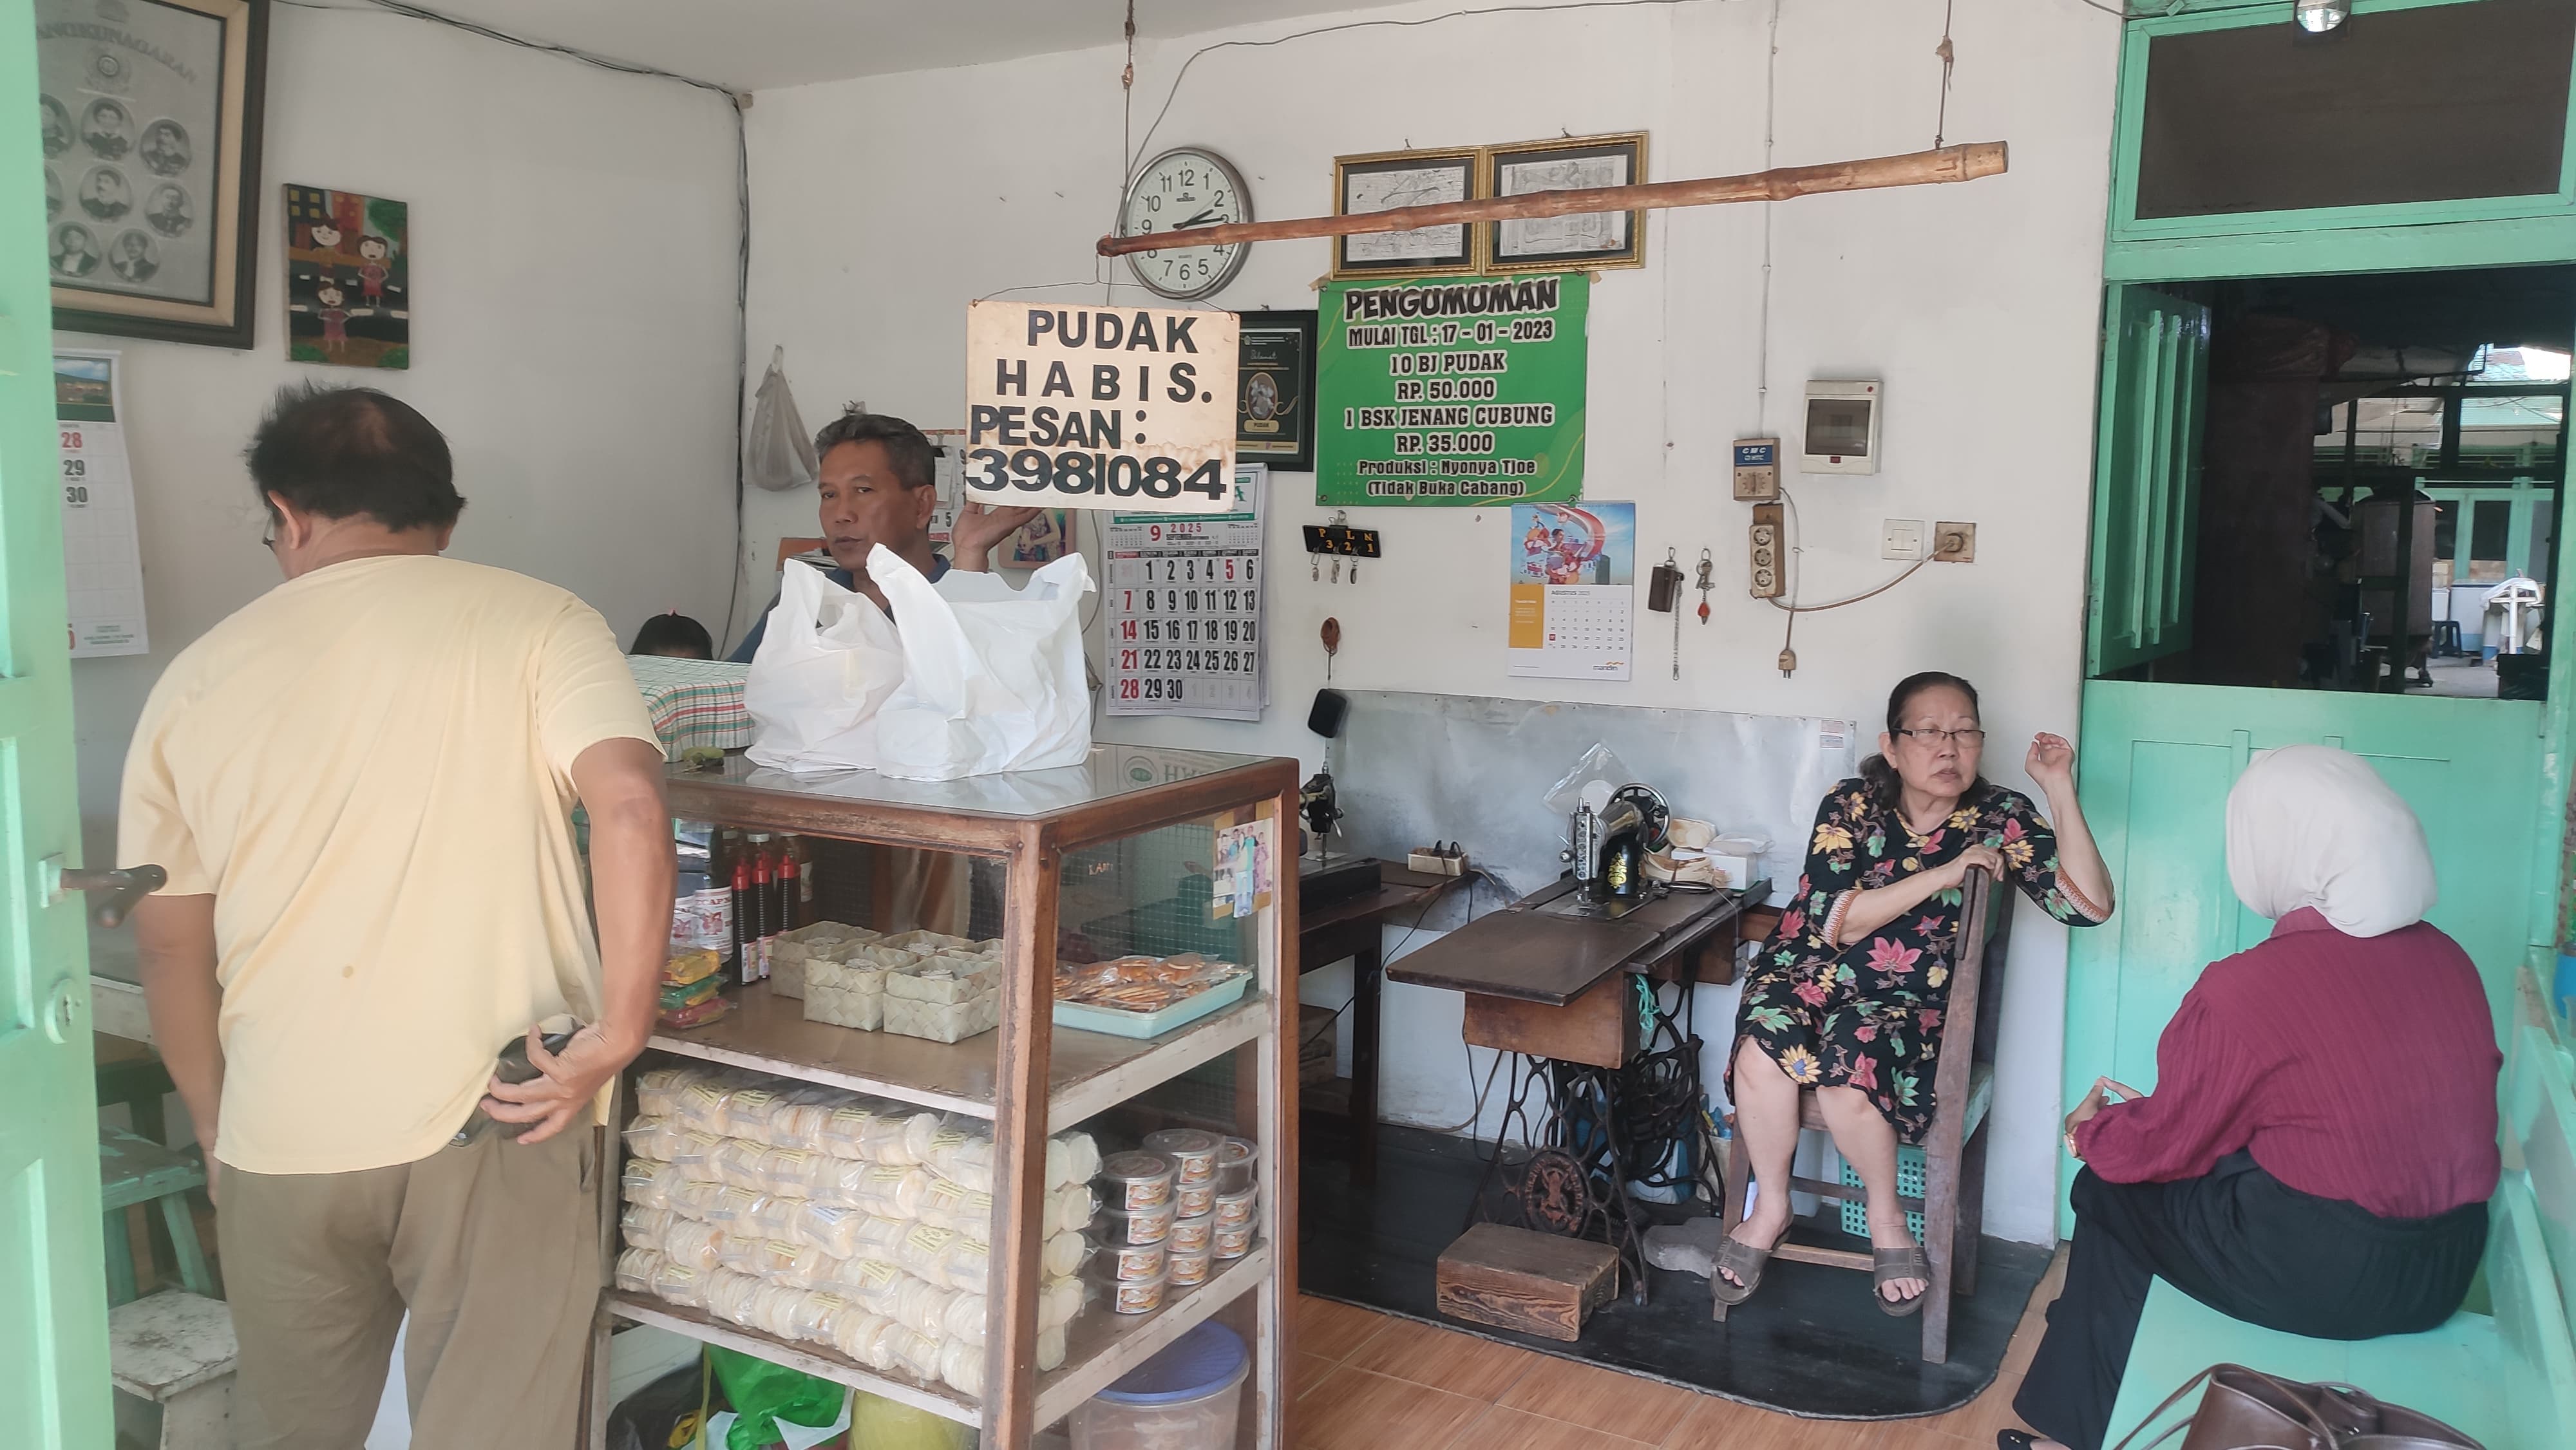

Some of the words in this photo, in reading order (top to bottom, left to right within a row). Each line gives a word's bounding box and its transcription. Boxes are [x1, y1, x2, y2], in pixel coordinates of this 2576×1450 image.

[1160, 175, 1172, 193] 11
[1179, 169, 1195, 187] 12
[1203, 173, 1209, 190] 1
[1147, 196, 1161, 212] 10
[1214, 190, 1224, 207] 2
[1141, 220, 1152, 235] 9
[1164, 260, 1173, 276] 7
[1180, 264, 1190, 281] 6
[1198, 259, 1209, 276] 5
[1345, 279, 1558, 319] PENGUMUMAN
[1028, 309, 1198, 353] PUDAK
[1349, 326, 1396, 346] MULAI
[1477, 323, 1492, 341] 01
[1513, 320, 1553, 341] 2023
[1392, 355, 1412, 373] 10
[1419, 355, 1438, 372] BJ
[1443, 352, 1505, 372] PUDAK
[996, 358, 1212, 403] HABIS.
[1396, 382, 1423, 400] RP.
[1429, 380, 1495, 399] 50.000
[1345, 410, 1353, 427] 1
[1360, 409, 1396, 427] BSK
[1400, 407, 1469, 426] JENANG
[1475, 405, 1553, 425] CUBUNG
[61, 431, 82, 448] 28
[1396, 434, 1422, 453] RP.
[1428, 433, 1493, 452] 35.000
[63, 460, 85, 476] 29
[966, 448, 1227, 501] 3981084
[1358, 460, 1426, 475] Produksi
[1441, 460, 1497, 476] Nyonya
[66, 486, 88, 503] 30
[1368, 481, 1414, 496] (Tidak
[1419, 481, 1455, 495] Buka
[1460, 480, 1526, 496] Cabang)
[1150, 525, 1161, 541] 9
[1170, 523, 1202, 533] 2025
[1326, 540, 1334, 549] 3
[1344, 541, 1352, 551] 2
[1145, 560, 1153, 580] 1
[1166, 560, 1175, 581] 2
[1186, 560, 1194, 581] 3
[1206, 559, 1214, 580] 4
[1226, 559, 1234, 580] 5
[1246, 559, 1254, 580] 6
[1124, 590, 1132, 610] 7
[1146, 590, 1155, 610] 8
[1168, 590, 1177, 610] 9
[1184, 590, 1198, 610] 10
[1204, 589, 1217, 610] 11
[1223, 589, 1237, 610] 12
[1244, 590, 1255, 611] 13
[1120, 619, 1137, 640] 14
[1143, 619, 1159, 640] 15
[1166, 619, 1180, 640] 16
[1186, 620, 1198, 641] 17
[1204, 619, 1218, 641] 18
[1224, 620, 1237, 641] 19
[1243, 621, 1255, 642] 20
[1121, 649, 1137, 670] 21
[1144, 648, 1161, 669] 22
[1166, 649, 1182, 670] 23
[1186, 650, 1200, 670] 24
[1205, 650, 1219, 671] 25
[1224, 650, 1238, 672] 26
[1244, 651, 1255, 672] 27
[1121, 679, 1139, 699] 28
[1144, 678, 1162, 699] 29
[1167, 679, 1182, 700] 30
